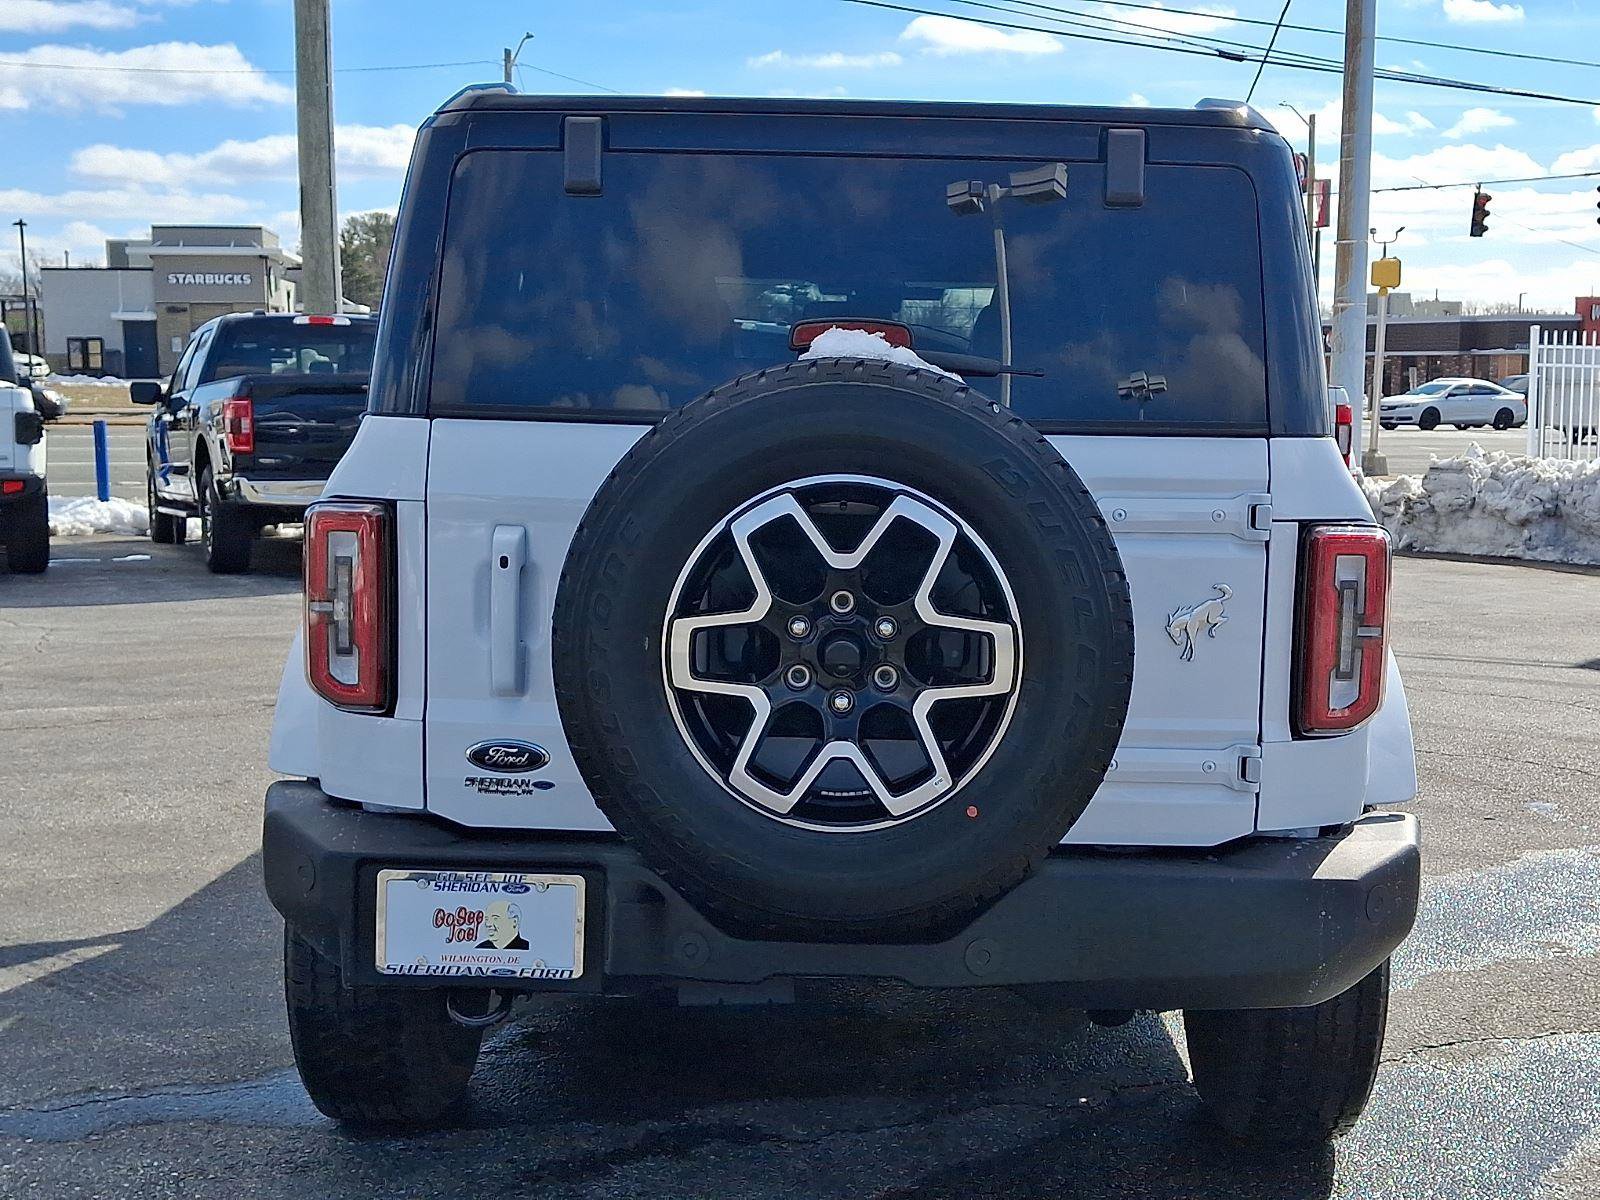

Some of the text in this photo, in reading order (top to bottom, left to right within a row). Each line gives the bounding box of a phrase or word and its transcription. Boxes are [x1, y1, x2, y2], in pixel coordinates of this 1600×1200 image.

[167, 273, 251, 285] STARBUCKS
[485, 746, 529, 765] Ford
[434, 881, 500, 893] SHERIDAN
